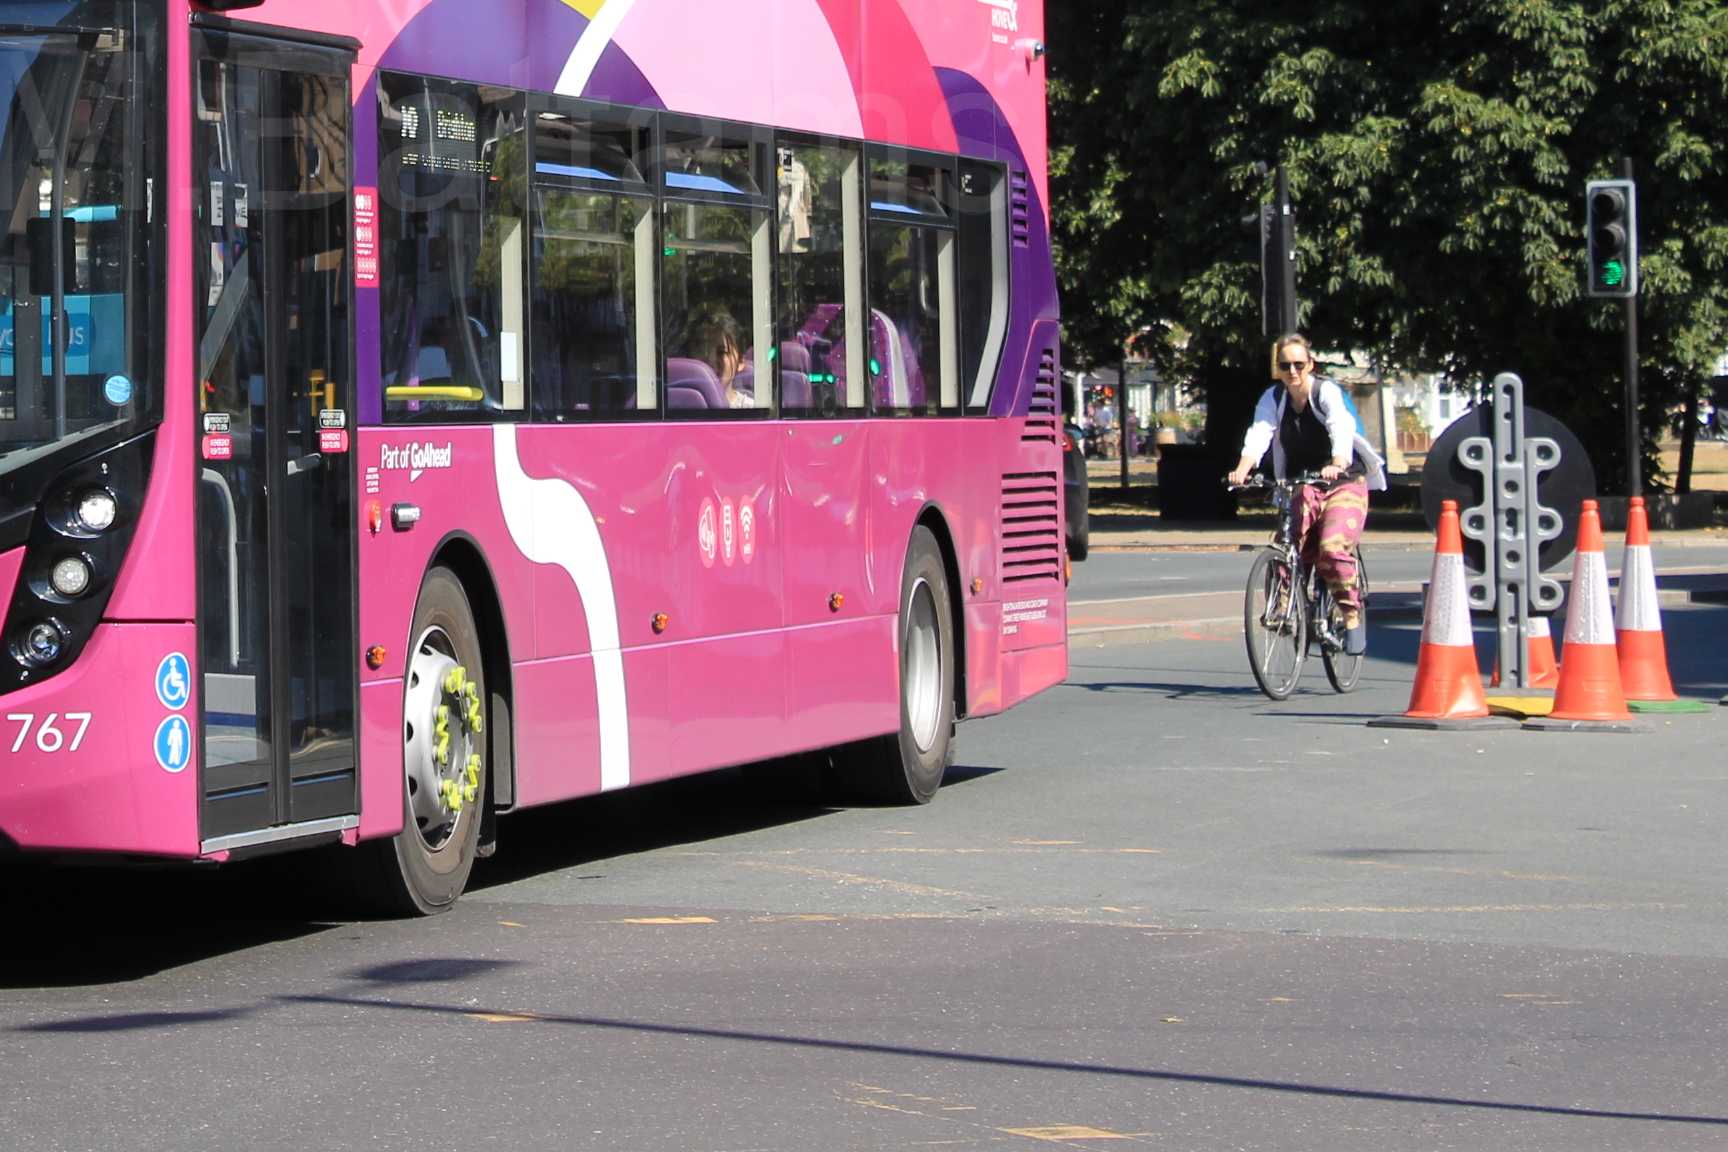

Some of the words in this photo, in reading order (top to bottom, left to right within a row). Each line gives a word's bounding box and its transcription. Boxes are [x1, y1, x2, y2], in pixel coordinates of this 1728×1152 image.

[381, 443, 399, 469] Part
[400, 443, 410, 468] of
[411, 442, 452, 469] GoAhead
[6, 712, 92, 753] 767
